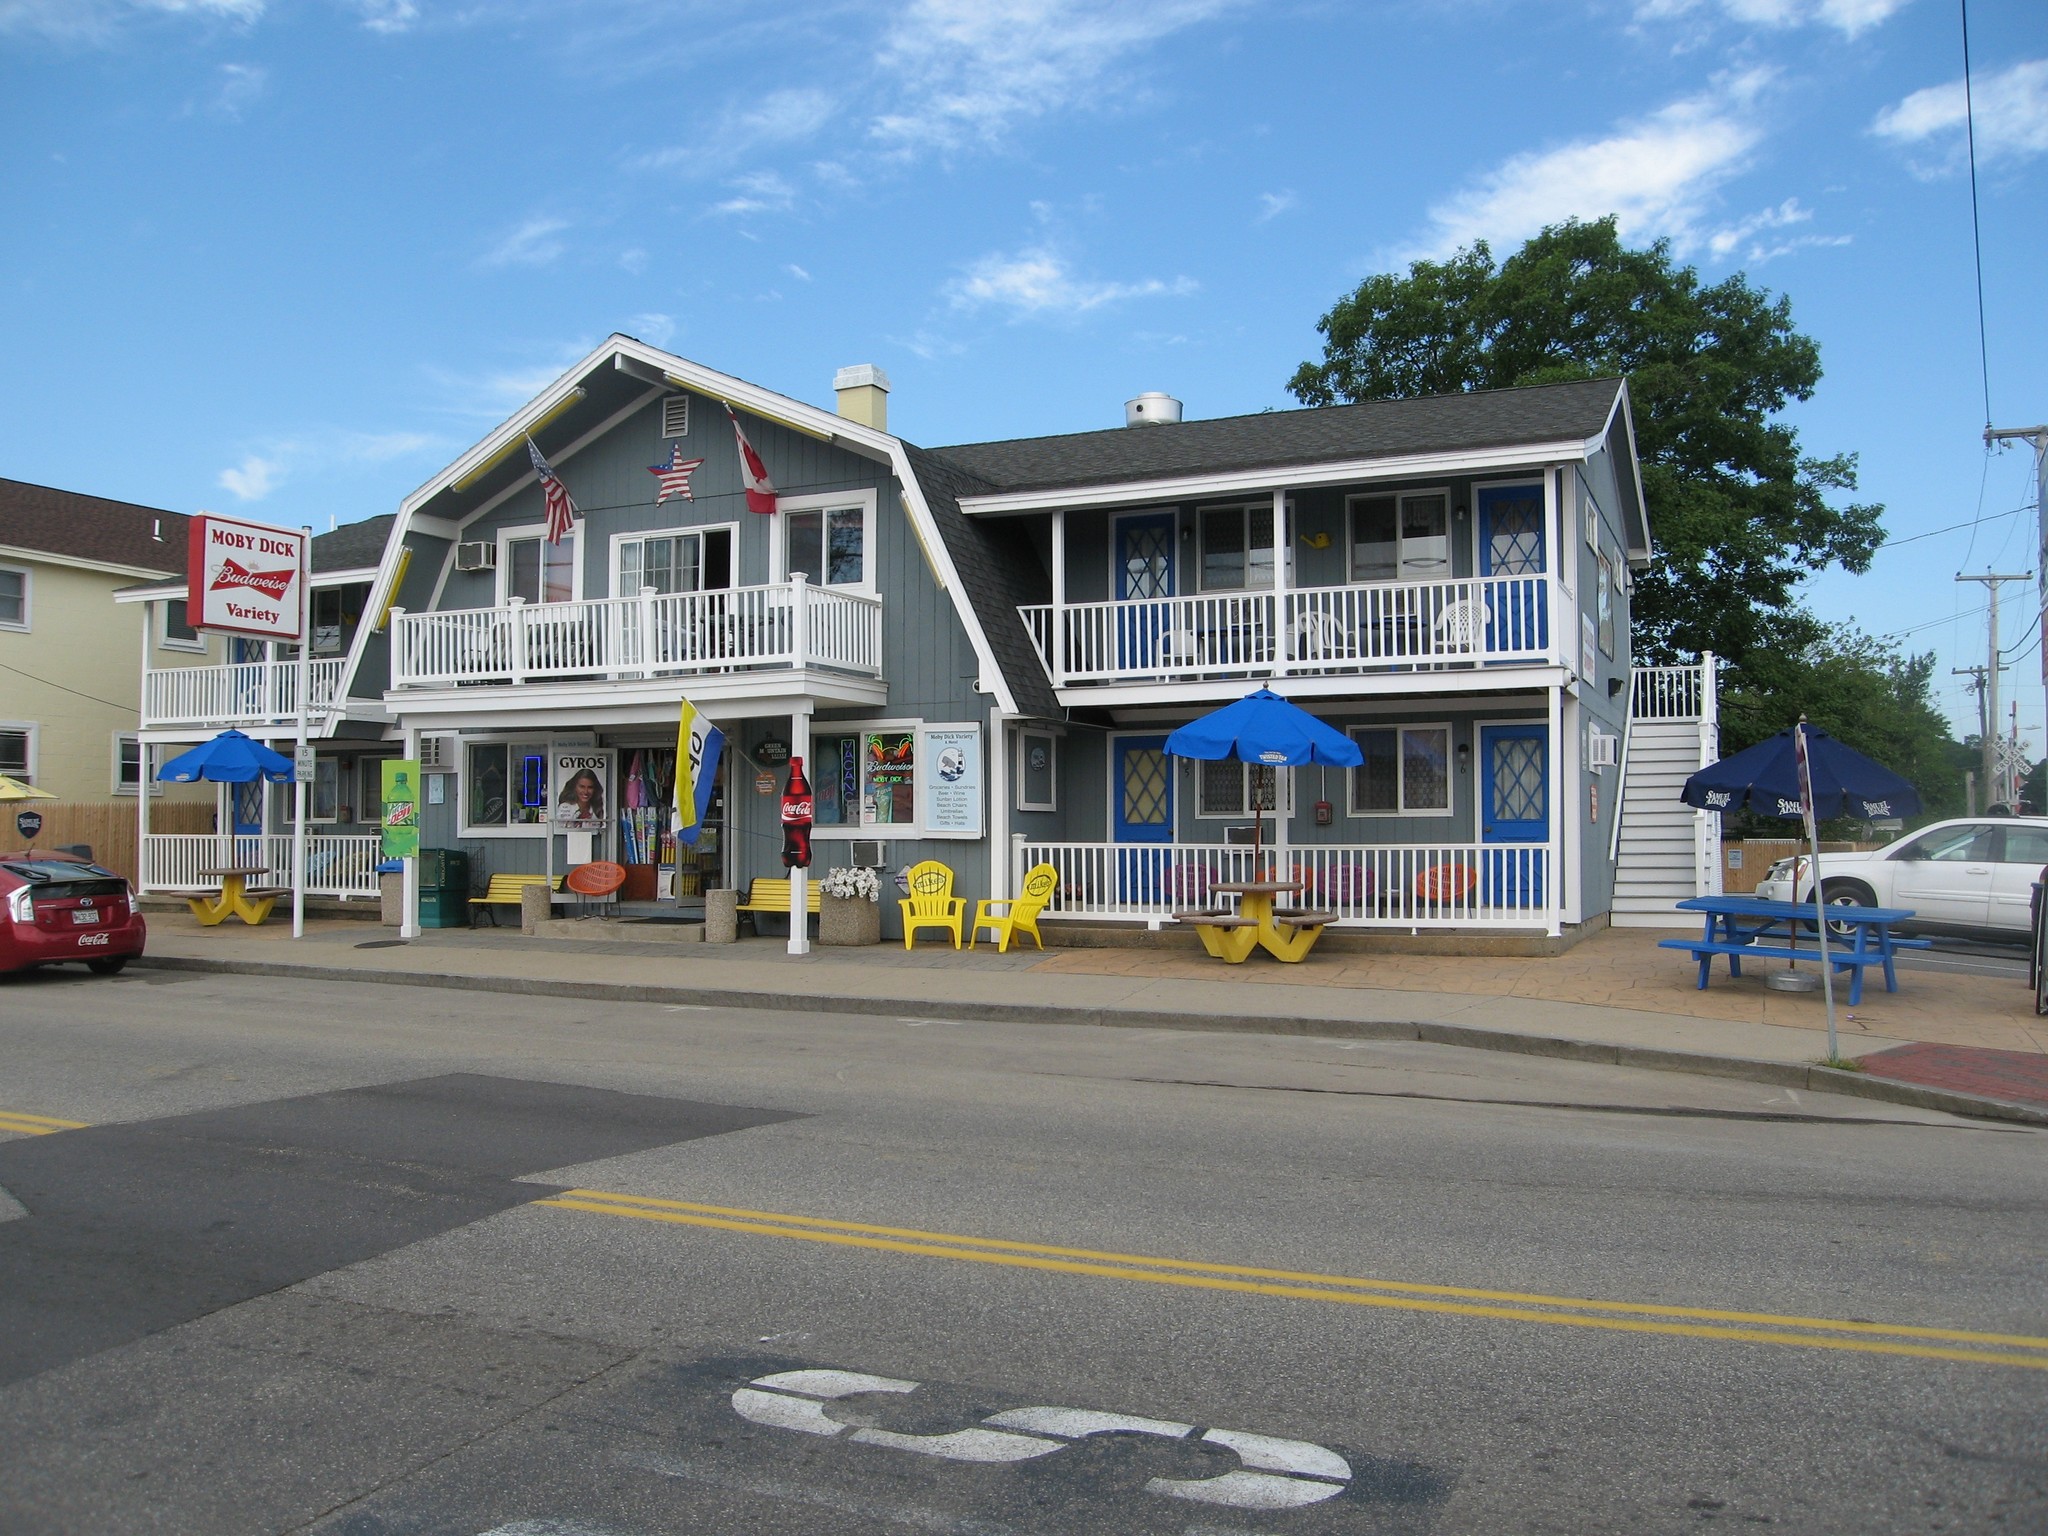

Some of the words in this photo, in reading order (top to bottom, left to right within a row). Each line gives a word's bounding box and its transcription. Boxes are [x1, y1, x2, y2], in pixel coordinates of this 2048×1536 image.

[212, 529, 255, 550] MOBY
[259, 537, 295, 558] DICK
[226, 602, 280, 624] Variety
[560, 756, 605, 769] GYROS
[1996, 741, 2029, 772] CROSSING
[1461, 763, 1466, 775] 6
[2014, 758, 2030, 774] ROAD
[1184, 768, 1190, 777] 5
[1705, 789, 1731, 802] SAMUEL
[1705, 797, 1727, 808] ADAMS
[1862, 800, 1891, 811] SAMUEL
[1778, 807, 1803, 815] ADAM
[1868, 807, 1891, 817] ADAMS
